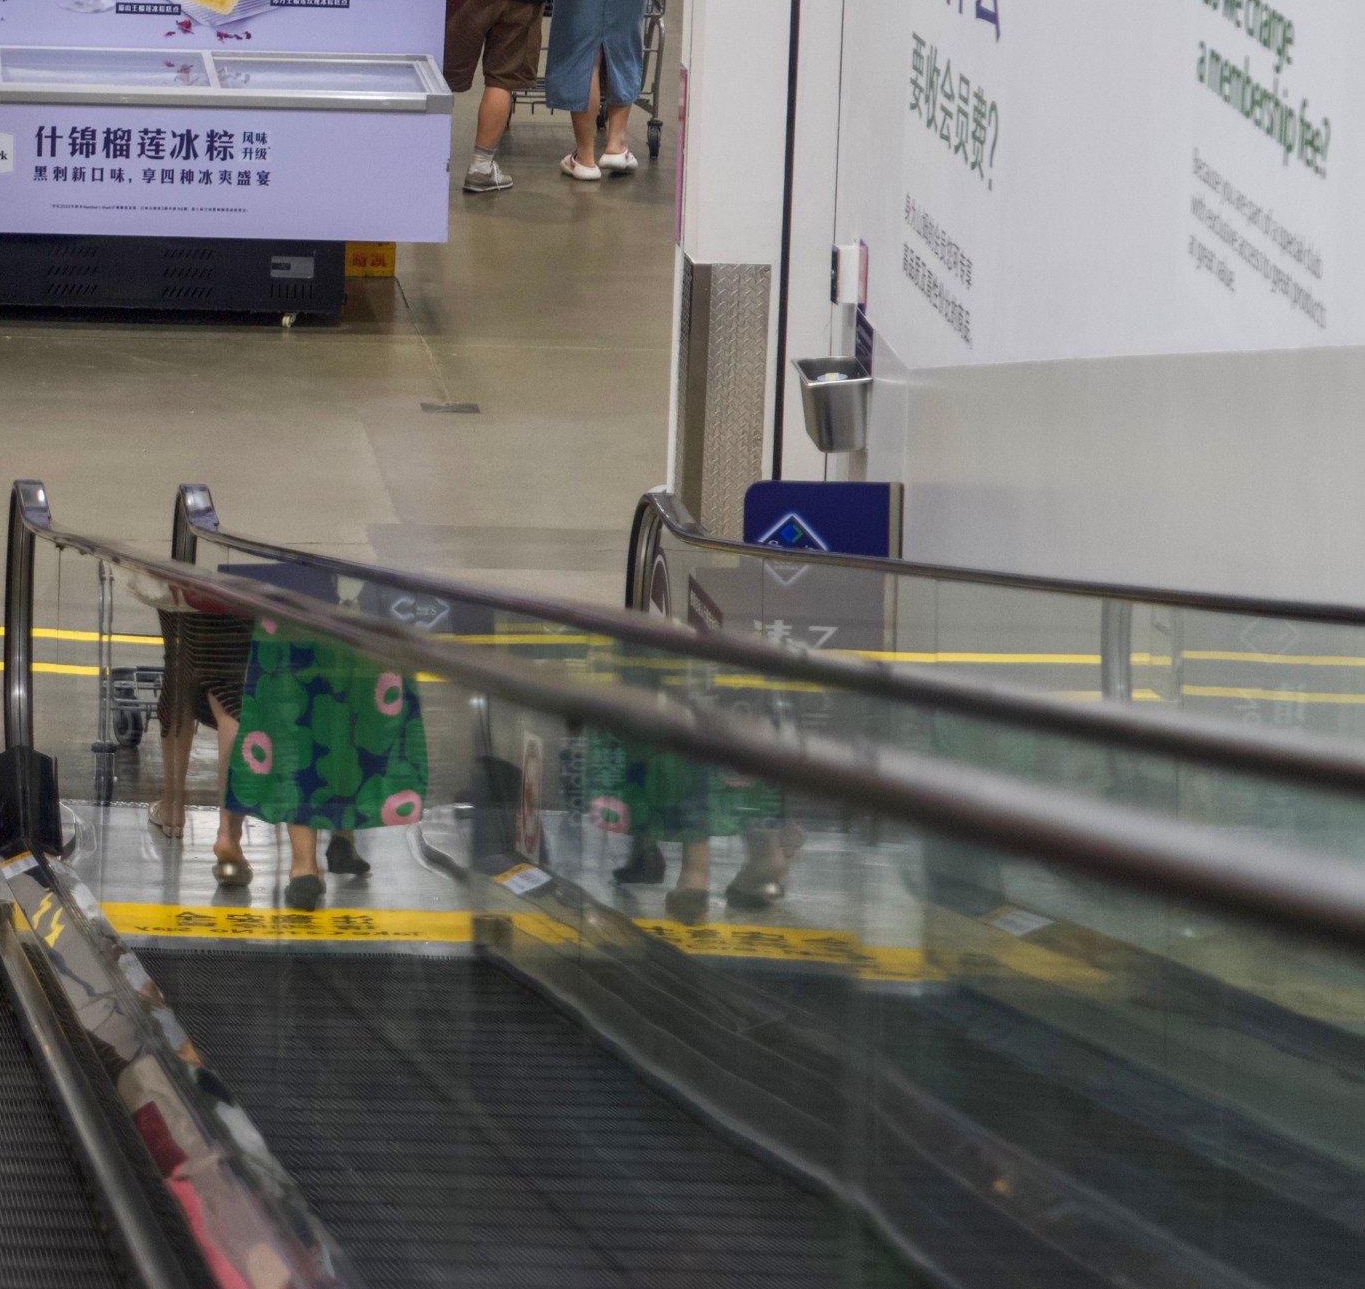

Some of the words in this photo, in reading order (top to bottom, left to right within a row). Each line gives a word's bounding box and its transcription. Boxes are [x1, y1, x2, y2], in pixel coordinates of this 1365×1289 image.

[1197, 40, 1207, 85] a
[1207, 47, 1296, 167] membership
[1296, 96, 1331, 179] fee?
[35, 125, 235, 162] 什锦榴莲冰粽
[242, 131, 269, 146] 风味
[242, 147, 268, 162] 升级
